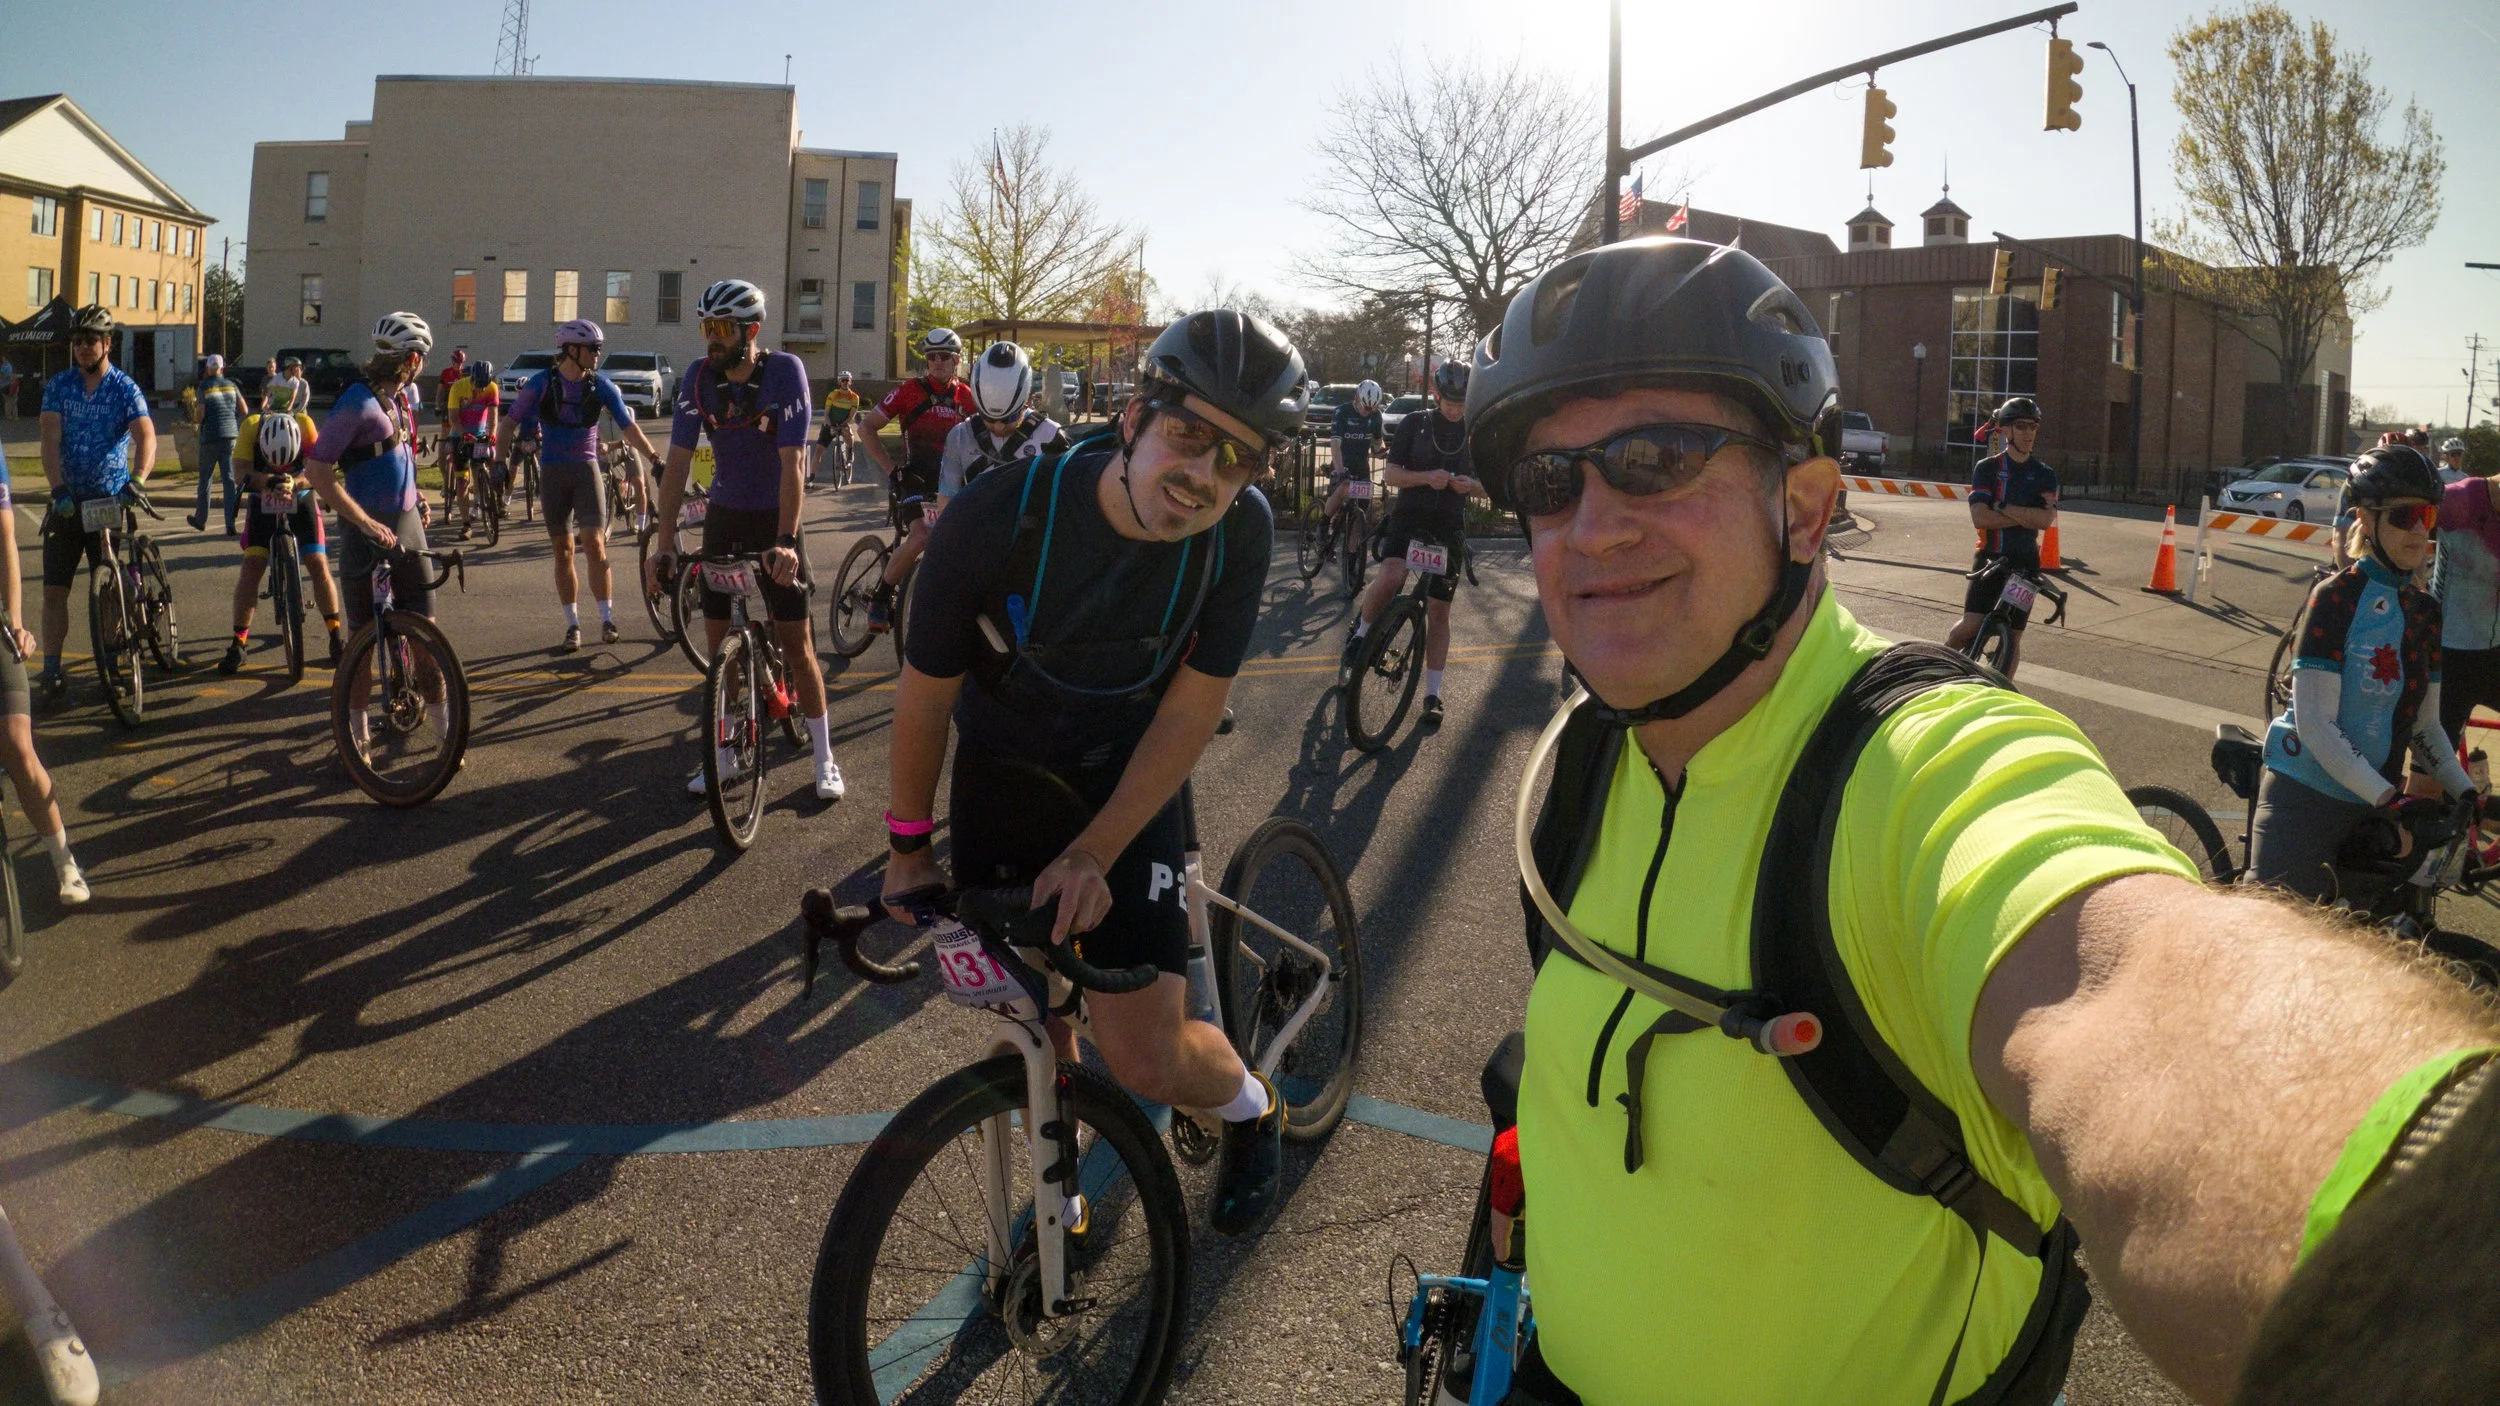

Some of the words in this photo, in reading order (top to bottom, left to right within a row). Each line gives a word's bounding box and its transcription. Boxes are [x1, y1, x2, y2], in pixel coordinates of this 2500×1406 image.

[1411, 549, 1441, 568] 2114
[710, 571, 748, 589] 2111
[939, 948, 1006, 988] 131
